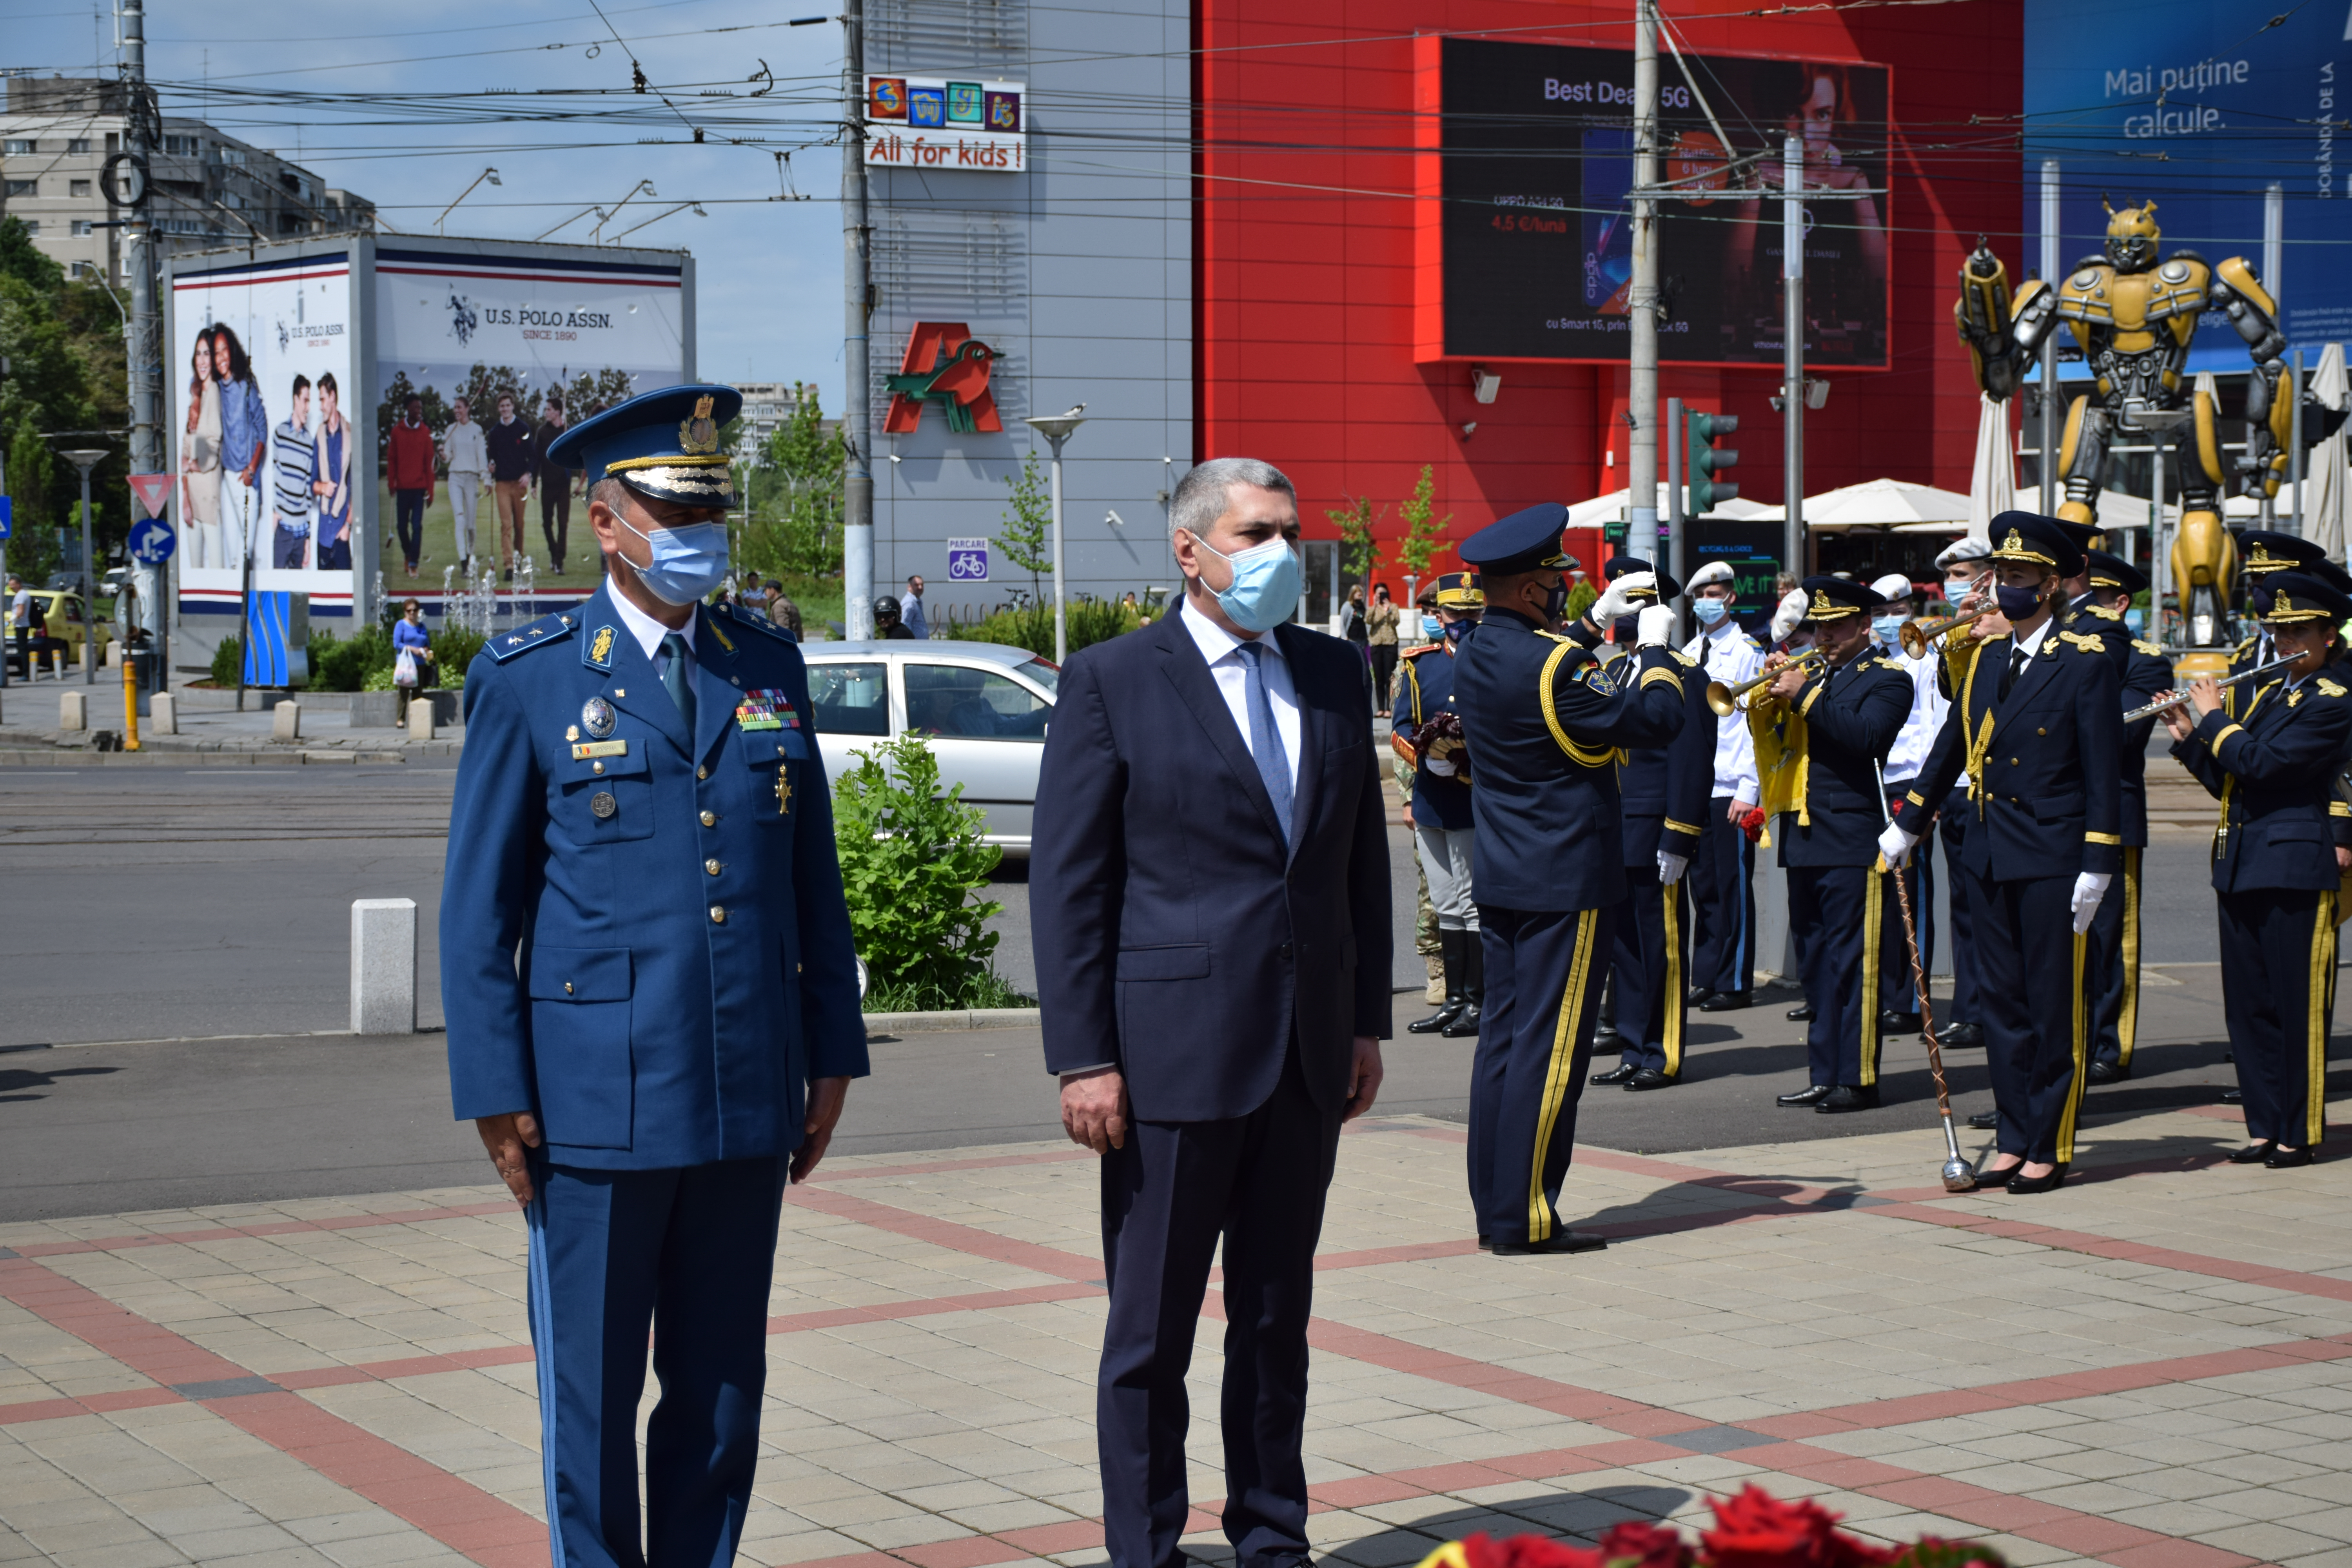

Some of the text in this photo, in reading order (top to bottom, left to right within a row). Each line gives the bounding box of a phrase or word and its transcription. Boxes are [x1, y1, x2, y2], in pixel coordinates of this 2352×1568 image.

[2105, 65, 2151, 98] Mai
[2319, 61, 2334, 83] LA
[1544, 78, 1690, 109] Best Dea 5G
[2319, 87, 2334, 109] DE
[2124, 103, 2226, 138] calcule.
[870, 135, 900, 162] All
[912, 137, 950, 164] for
[1682, 162, 1690, 174] 6
[1492, 215, 1515, 232] 4,5
[486, 309, 614, 328] U.S. POLO ASSN.
[1546, 319, 1559, 329] cu
[1560, 318, 1590, 330] Smart
[1607, 319, 1626, 332] prin
[305, 325, 324, 337] POLO
[523, 330, 577, 341] SINCE 1890
